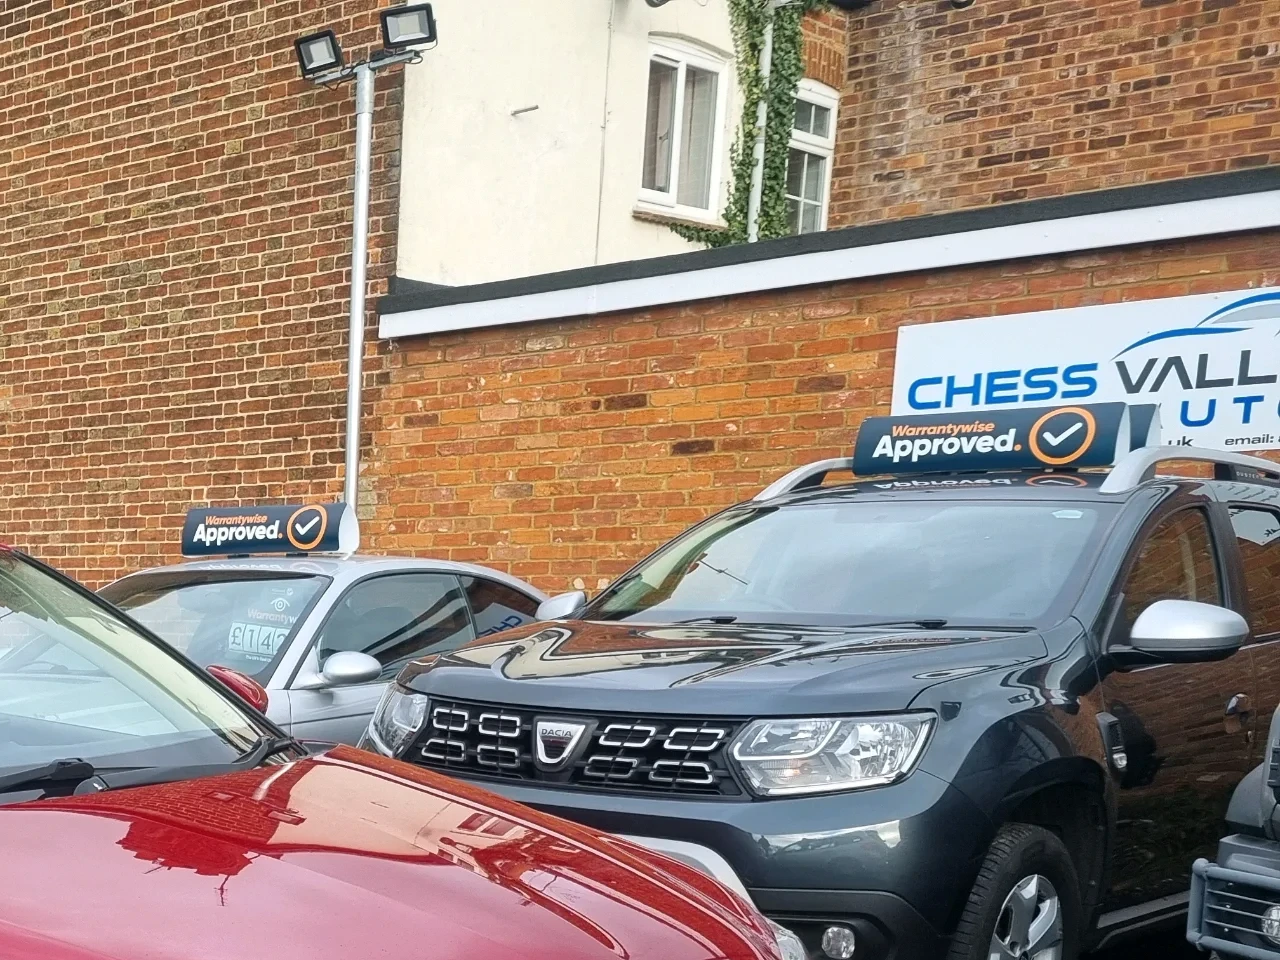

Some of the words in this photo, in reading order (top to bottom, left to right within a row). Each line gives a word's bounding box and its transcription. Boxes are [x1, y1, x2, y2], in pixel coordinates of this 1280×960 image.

[907, 362, 1099, 411] CHESS
[1114, 349, 1278, 394] VALL
[1158, 395, 1280, 430] UT
[892, 420, 995, 438] Warrantywise
[1224, 434, 1275, 446] email:
[872, 428, 1022, 463] Approved.
[205, 513, 268, 526] Warrantywise
[193, 519, 283, 546] Approved.
[541, 728, 572, 737] DACIA
